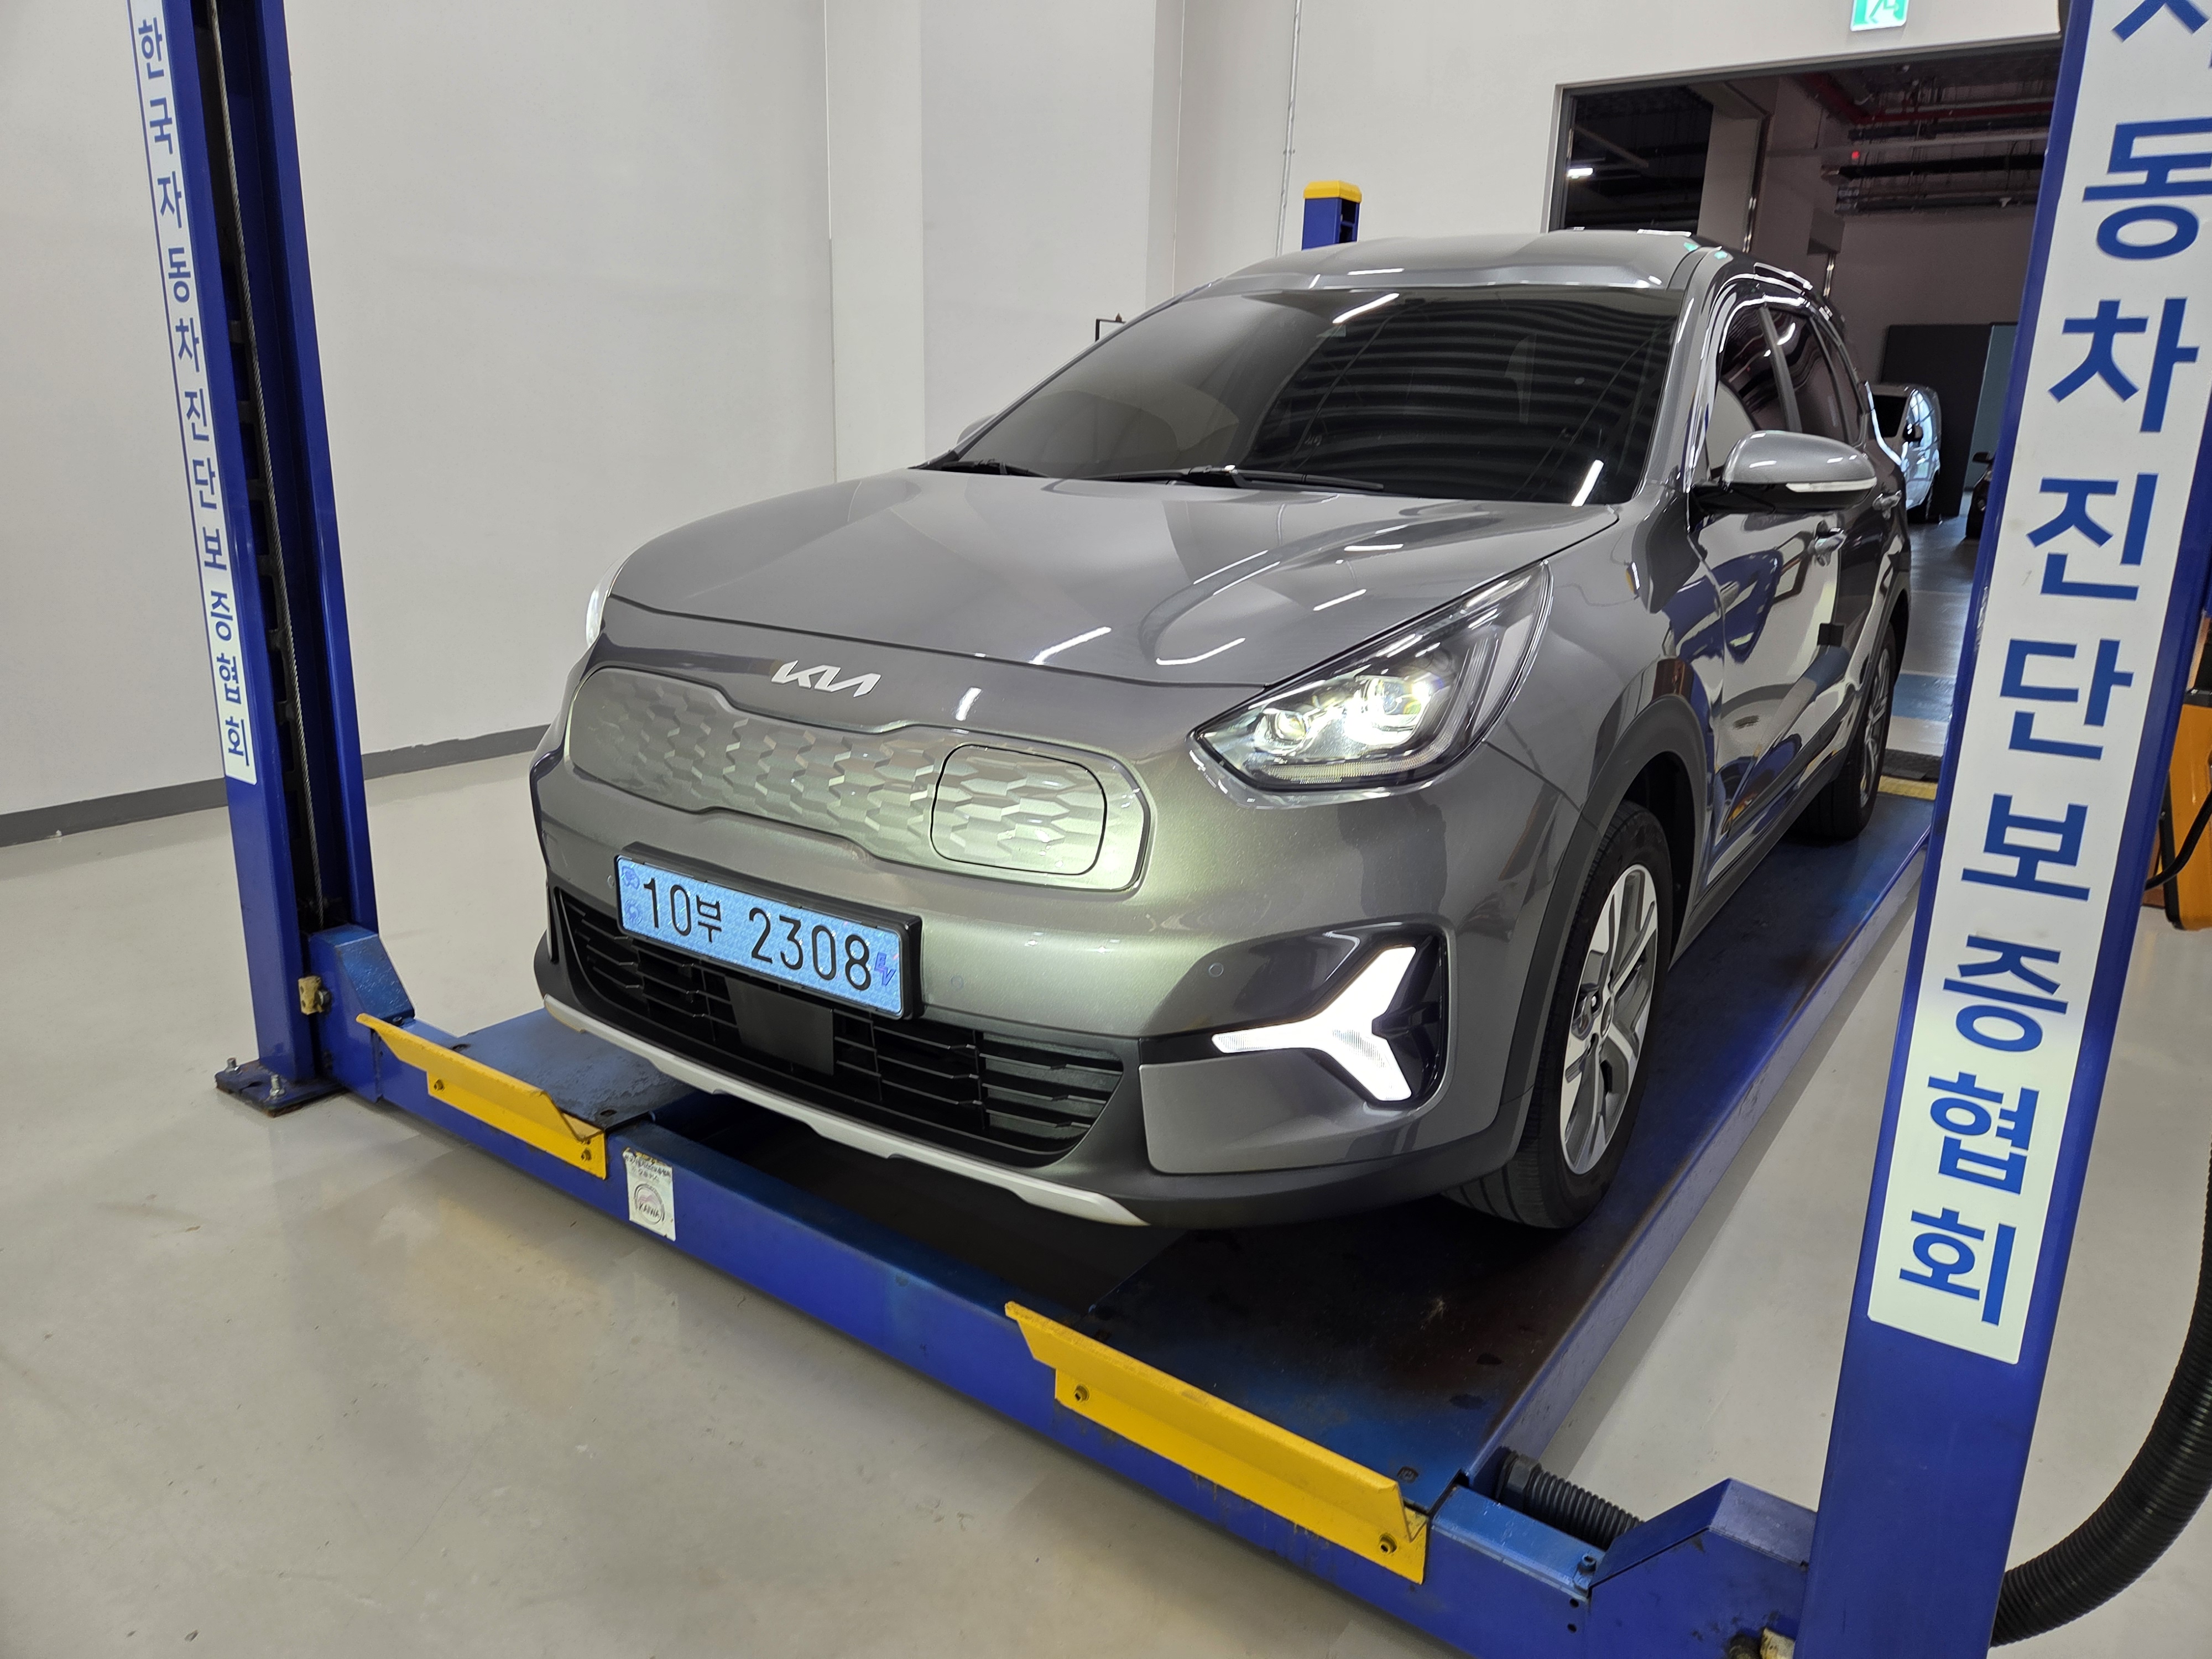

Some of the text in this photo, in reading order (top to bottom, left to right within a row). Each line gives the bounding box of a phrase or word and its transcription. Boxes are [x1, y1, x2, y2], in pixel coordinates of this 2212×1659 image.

[138, 17, 249, 766] 한국자동차진단보증협회
[771, 660, 881, 697] KIA
[643, 877, 872, 991] 10부 2308
[874, 952, 895, 987] EV
